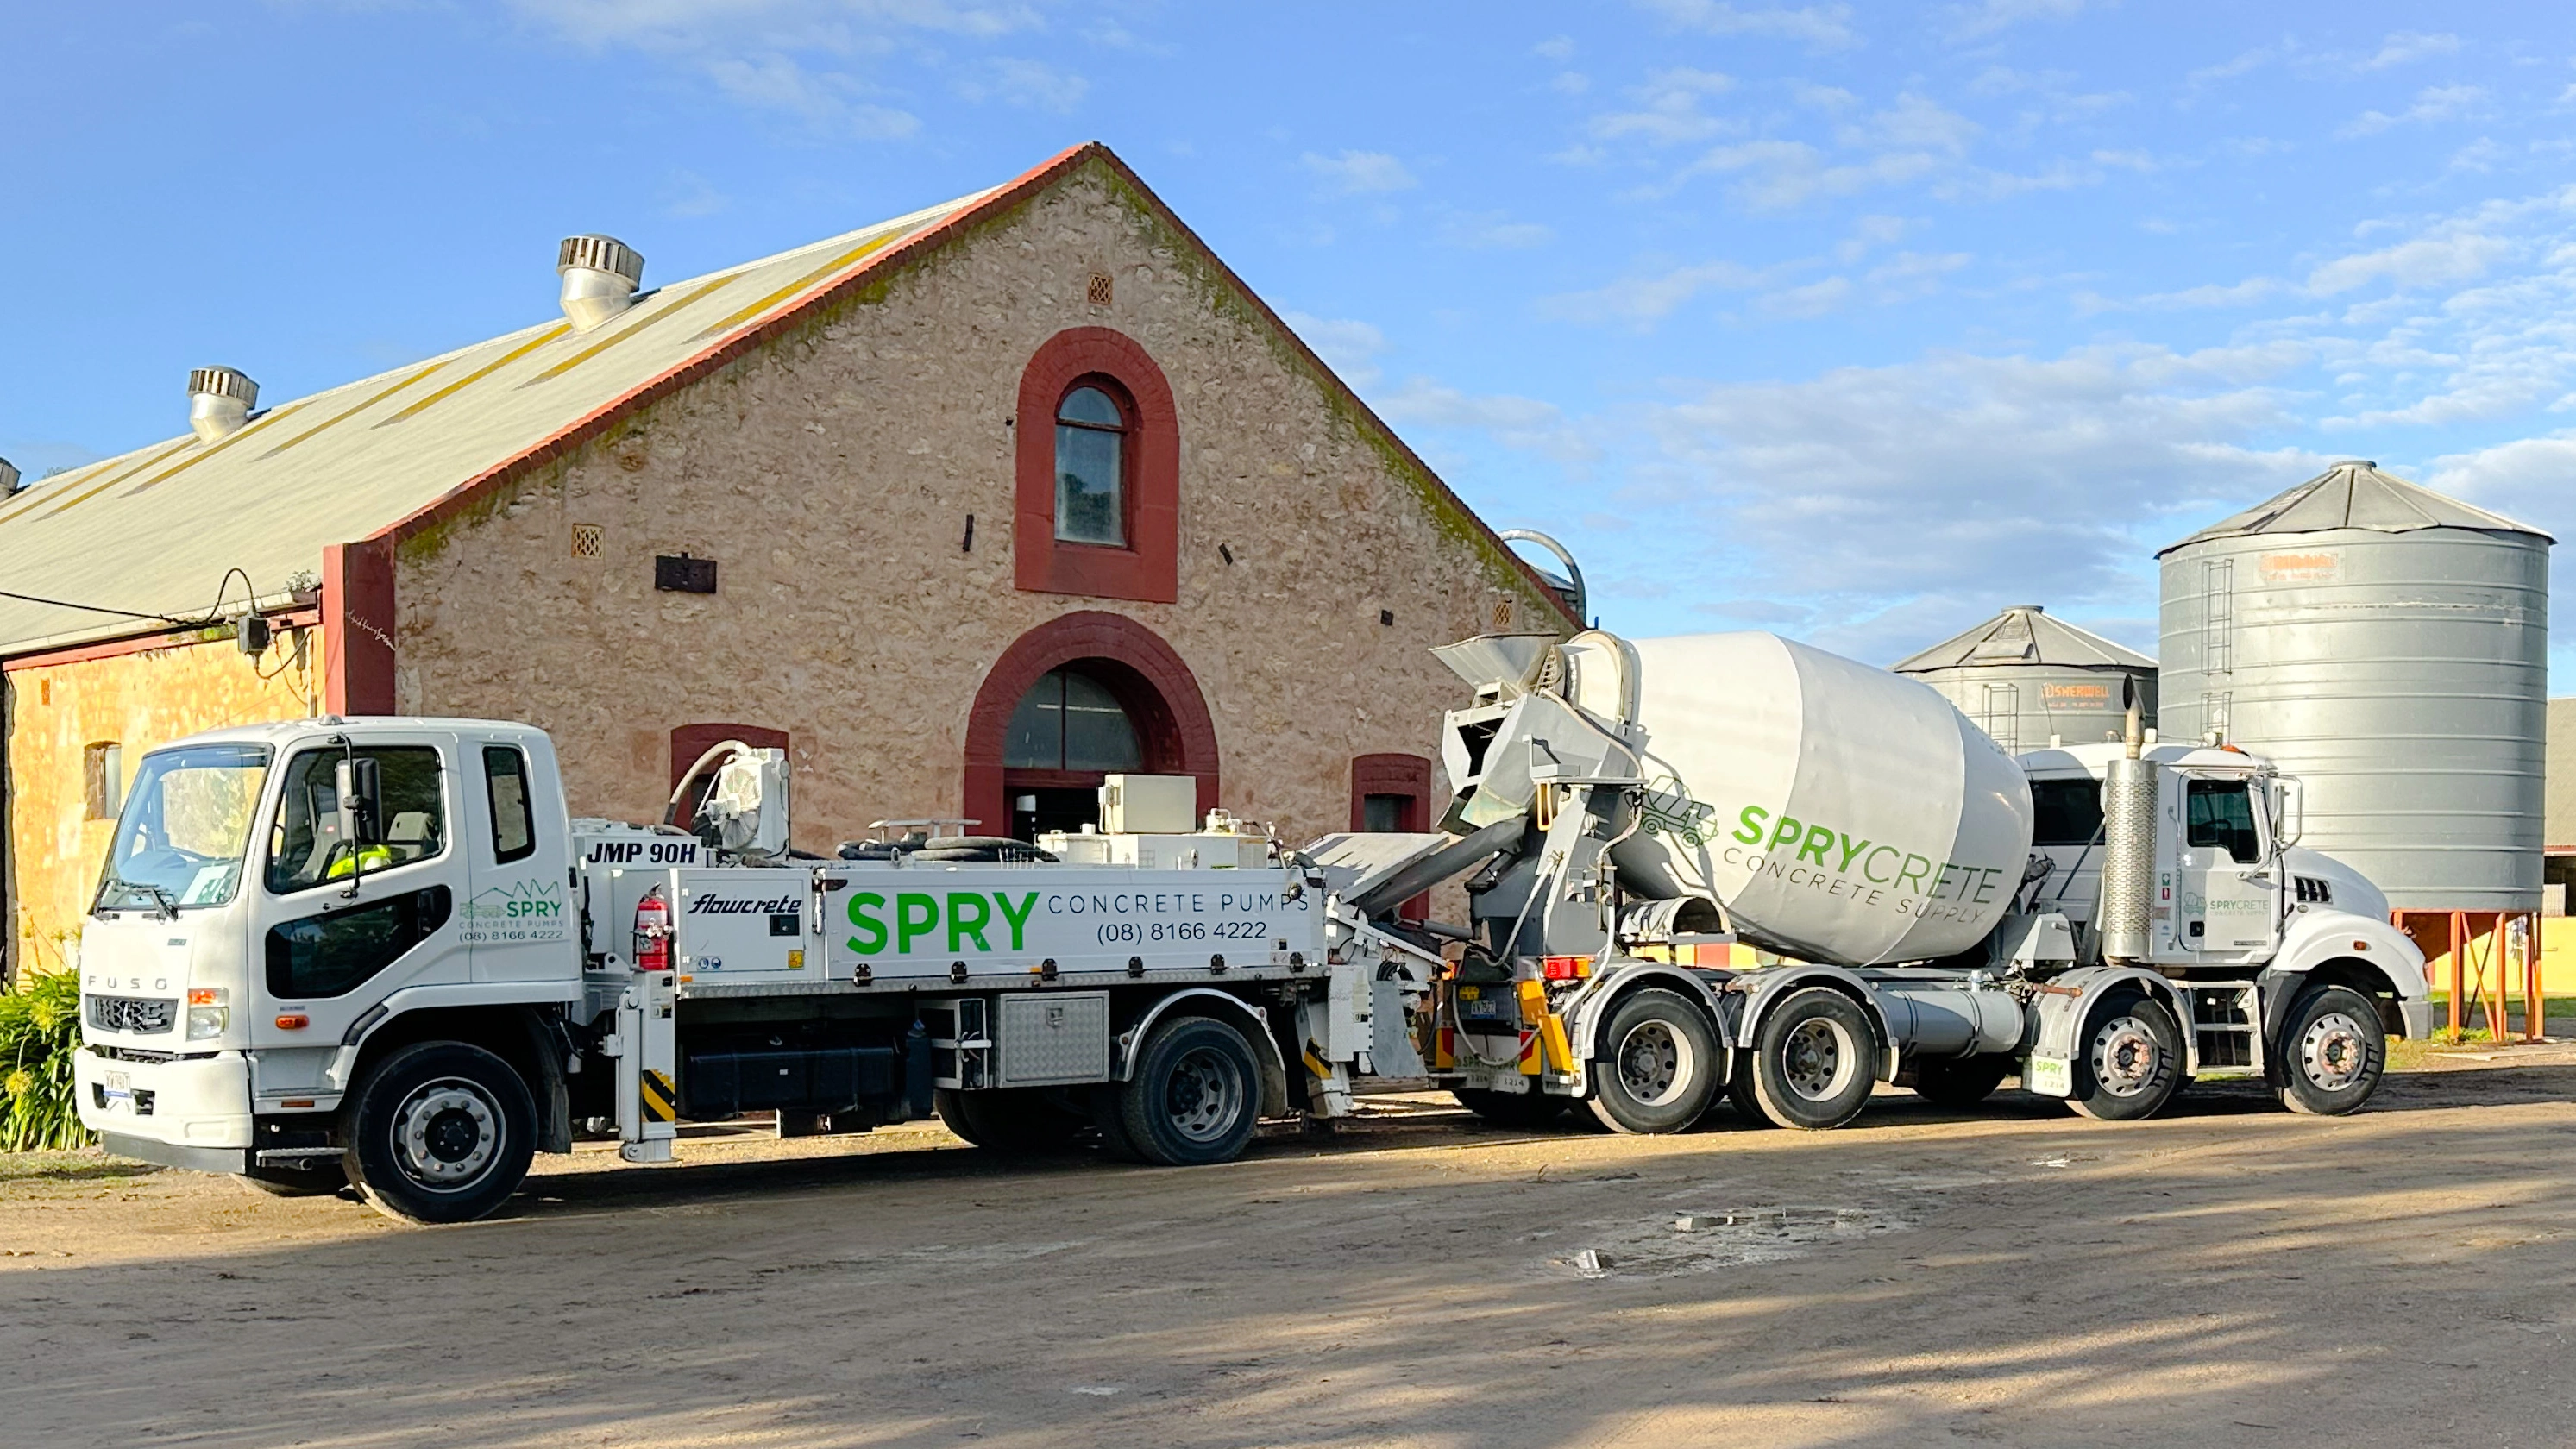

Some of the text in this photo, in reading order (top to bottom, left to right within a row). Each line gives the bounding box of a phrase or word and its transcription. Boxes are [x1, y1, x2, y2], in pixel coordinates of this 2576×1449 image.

[587, 843, 696, 863] JMP 90H
[1731, 806, 2003, 904] SPRYCRETE
[1724, 847, 1986, 924] CONCRETE SUPPLY
[506, 900, 562, 918] SPRY
[687, 894, 802, 914] flowcrete
[2209, 900, 2269, 910] SPRYCRETE
[459, 919, 564, 930] CONCRETE PUMPS
[846, 891, 1309, 956] SPRY CONCRETE PUMPS
[459, 930, 564, 944] (08) 8166 4222
[1096, 921, 1267, 947] (08) 8166 4222
[2036, 1061, 2064, 1076] SPRY
